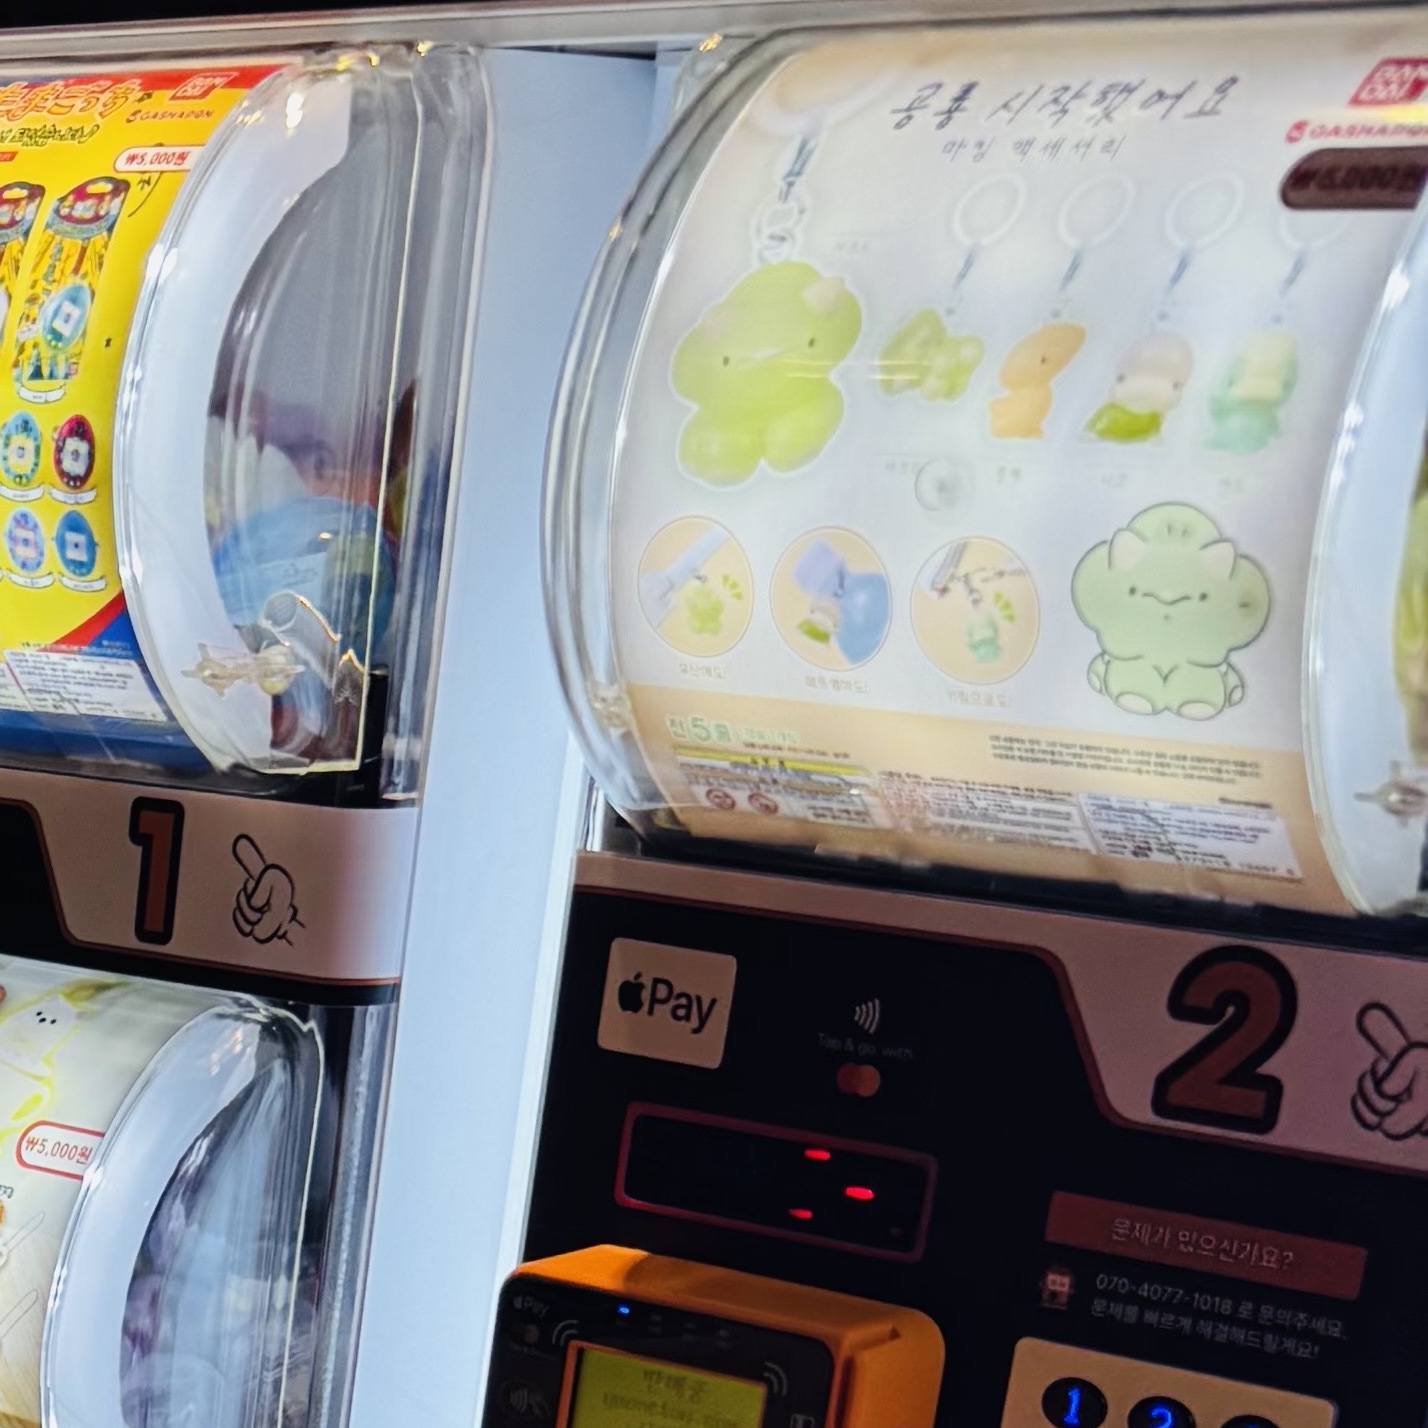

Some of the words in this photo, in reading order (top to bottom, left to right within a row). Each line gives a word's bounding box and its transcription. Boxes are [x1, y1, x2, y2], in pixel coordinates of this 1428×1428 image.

[890, 80, 980, 131] 공룡
[128, 795, 185, 946] 1
[648, 976, 718, 1036] Pay
[1151, 944, 1299, 1136] 2
[1110, 1217, 1173, 1250] 문제가
[1062, 1386, 1082, 1428] 1
